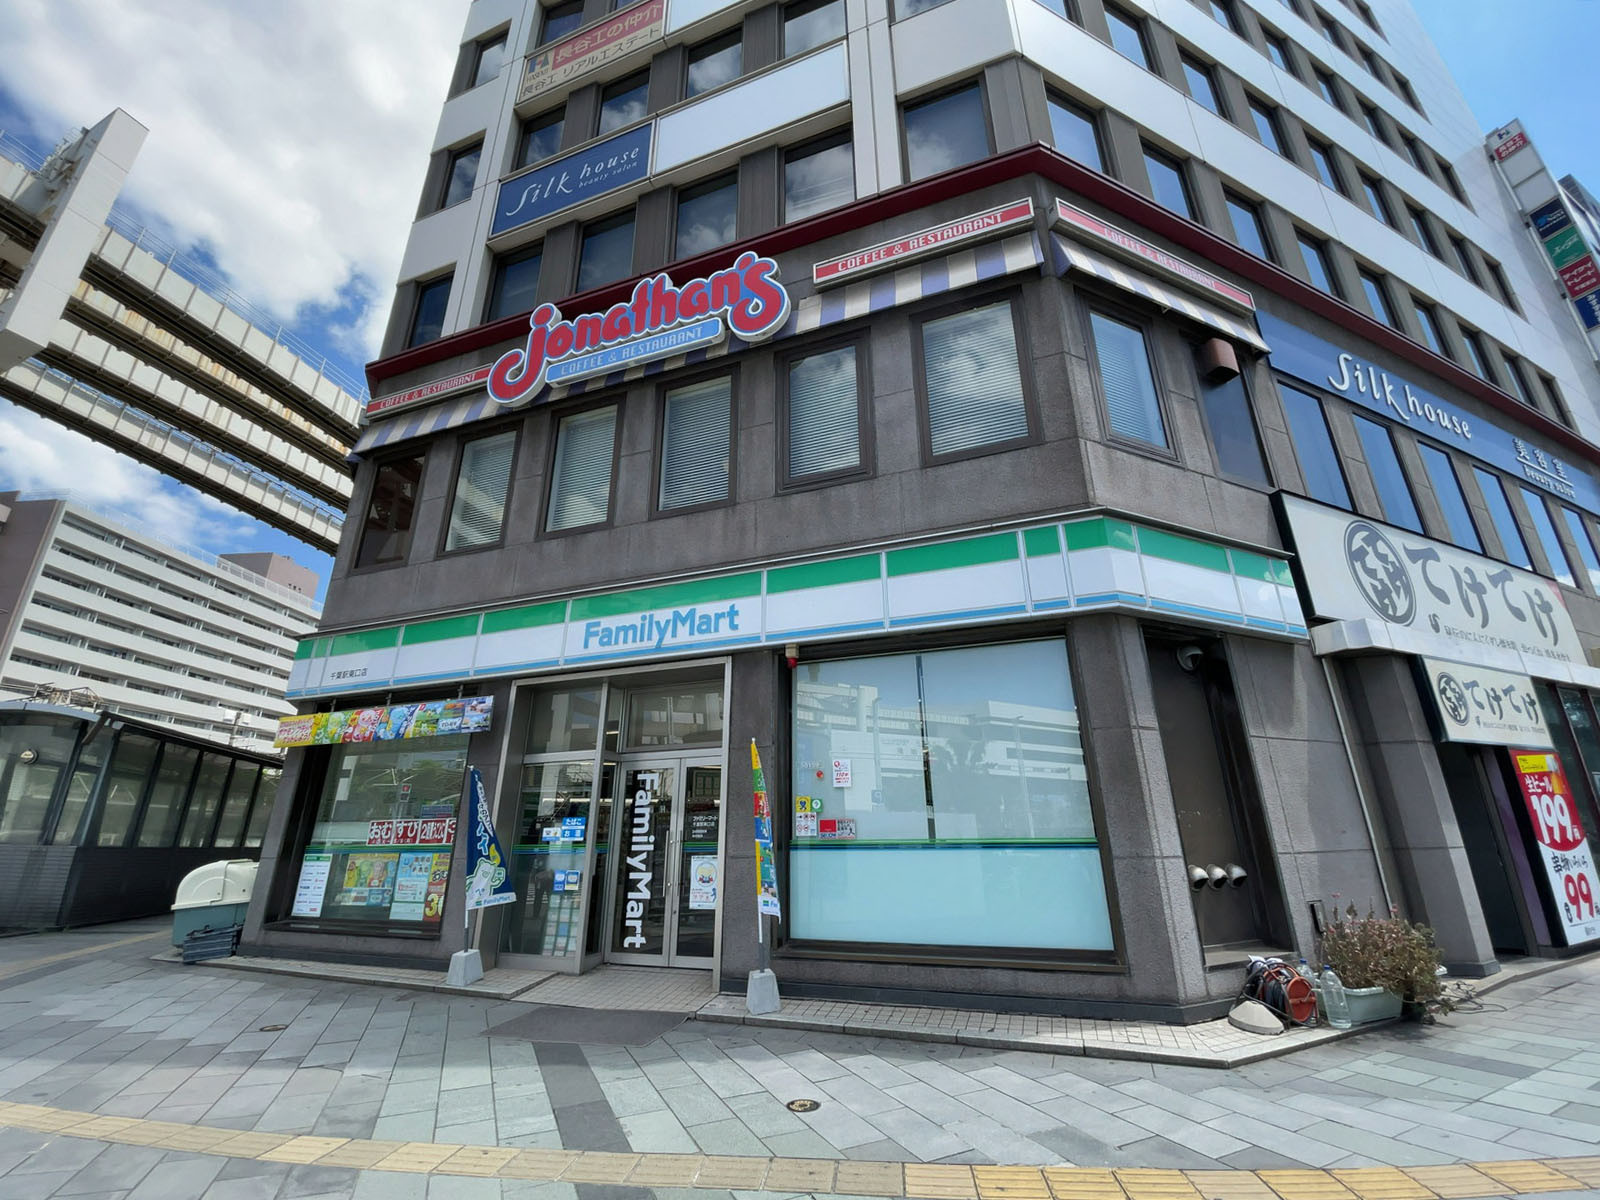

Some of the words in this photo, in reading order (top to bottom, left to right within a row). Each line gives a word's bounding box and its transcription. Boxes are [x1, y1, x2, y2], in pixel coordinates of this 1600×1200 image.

[557, 4, 663, 63] 長谷工の仲介
[563, 28, 660, 78] リアルエステート
[505, 171, 574, 216] Silk
[579, 147, 639, 180] house
[837, 248, 888, 272] COFFEE
[893, 243, 904, 255] &
[908, 212, 1004, 250] RESTAURANT
[560, 354, 606, 376] COFFEE
[607, 350, 618, 362] &
[621, 325, 704, 359] RESTAURANT
[380, 393, 409, 410] COFFEE
[421, 372, 477, 397] RESTAURANT
[1328, 352, 1411, 421] Silk
[1402, 384, 1473, 440] house
[1402, 541, 1559, 647] てけてけ
[583, 603, 739, 649] FamilyMart
[331, 667, 369, 681] 千葉駅東口店
[1462, 679, 1540, 725] てけてけ
[623, 772, 659, 948] FamilyMart
